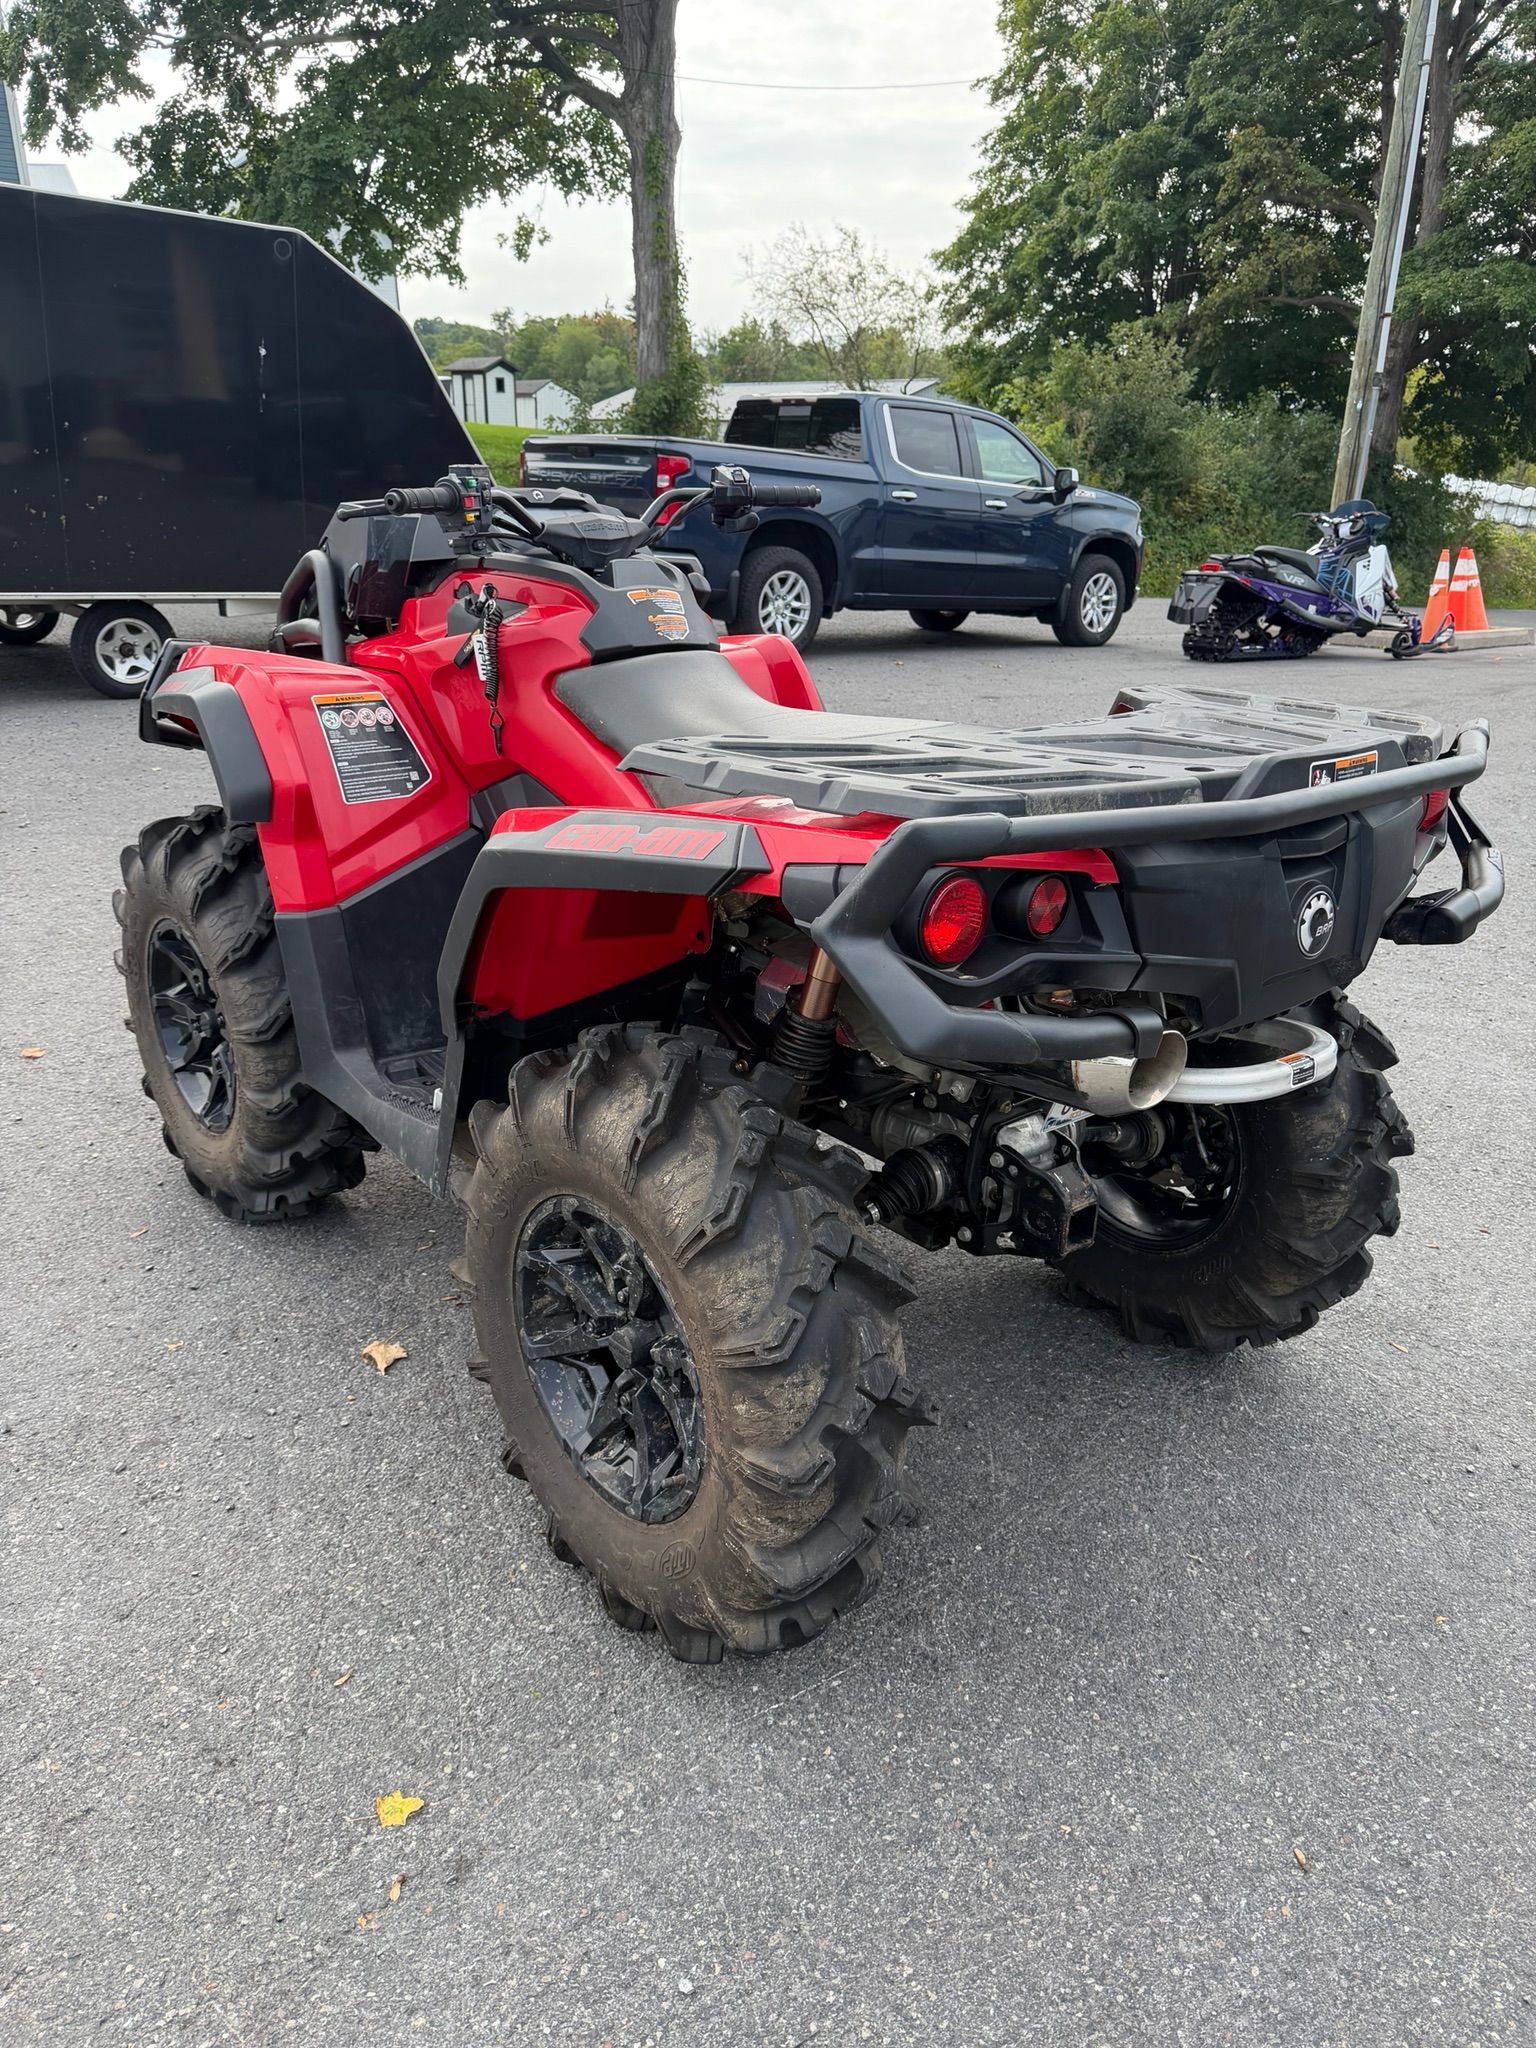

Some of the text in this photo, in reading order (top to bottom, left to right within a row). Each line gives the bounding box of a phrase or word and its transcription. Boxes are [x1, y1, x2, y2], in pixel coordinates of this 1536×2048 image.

[544, 825, 727, 860] can-am
[1315, 920, 1333, 938] BRP
[661, 1546, 692, 1579] ITP
